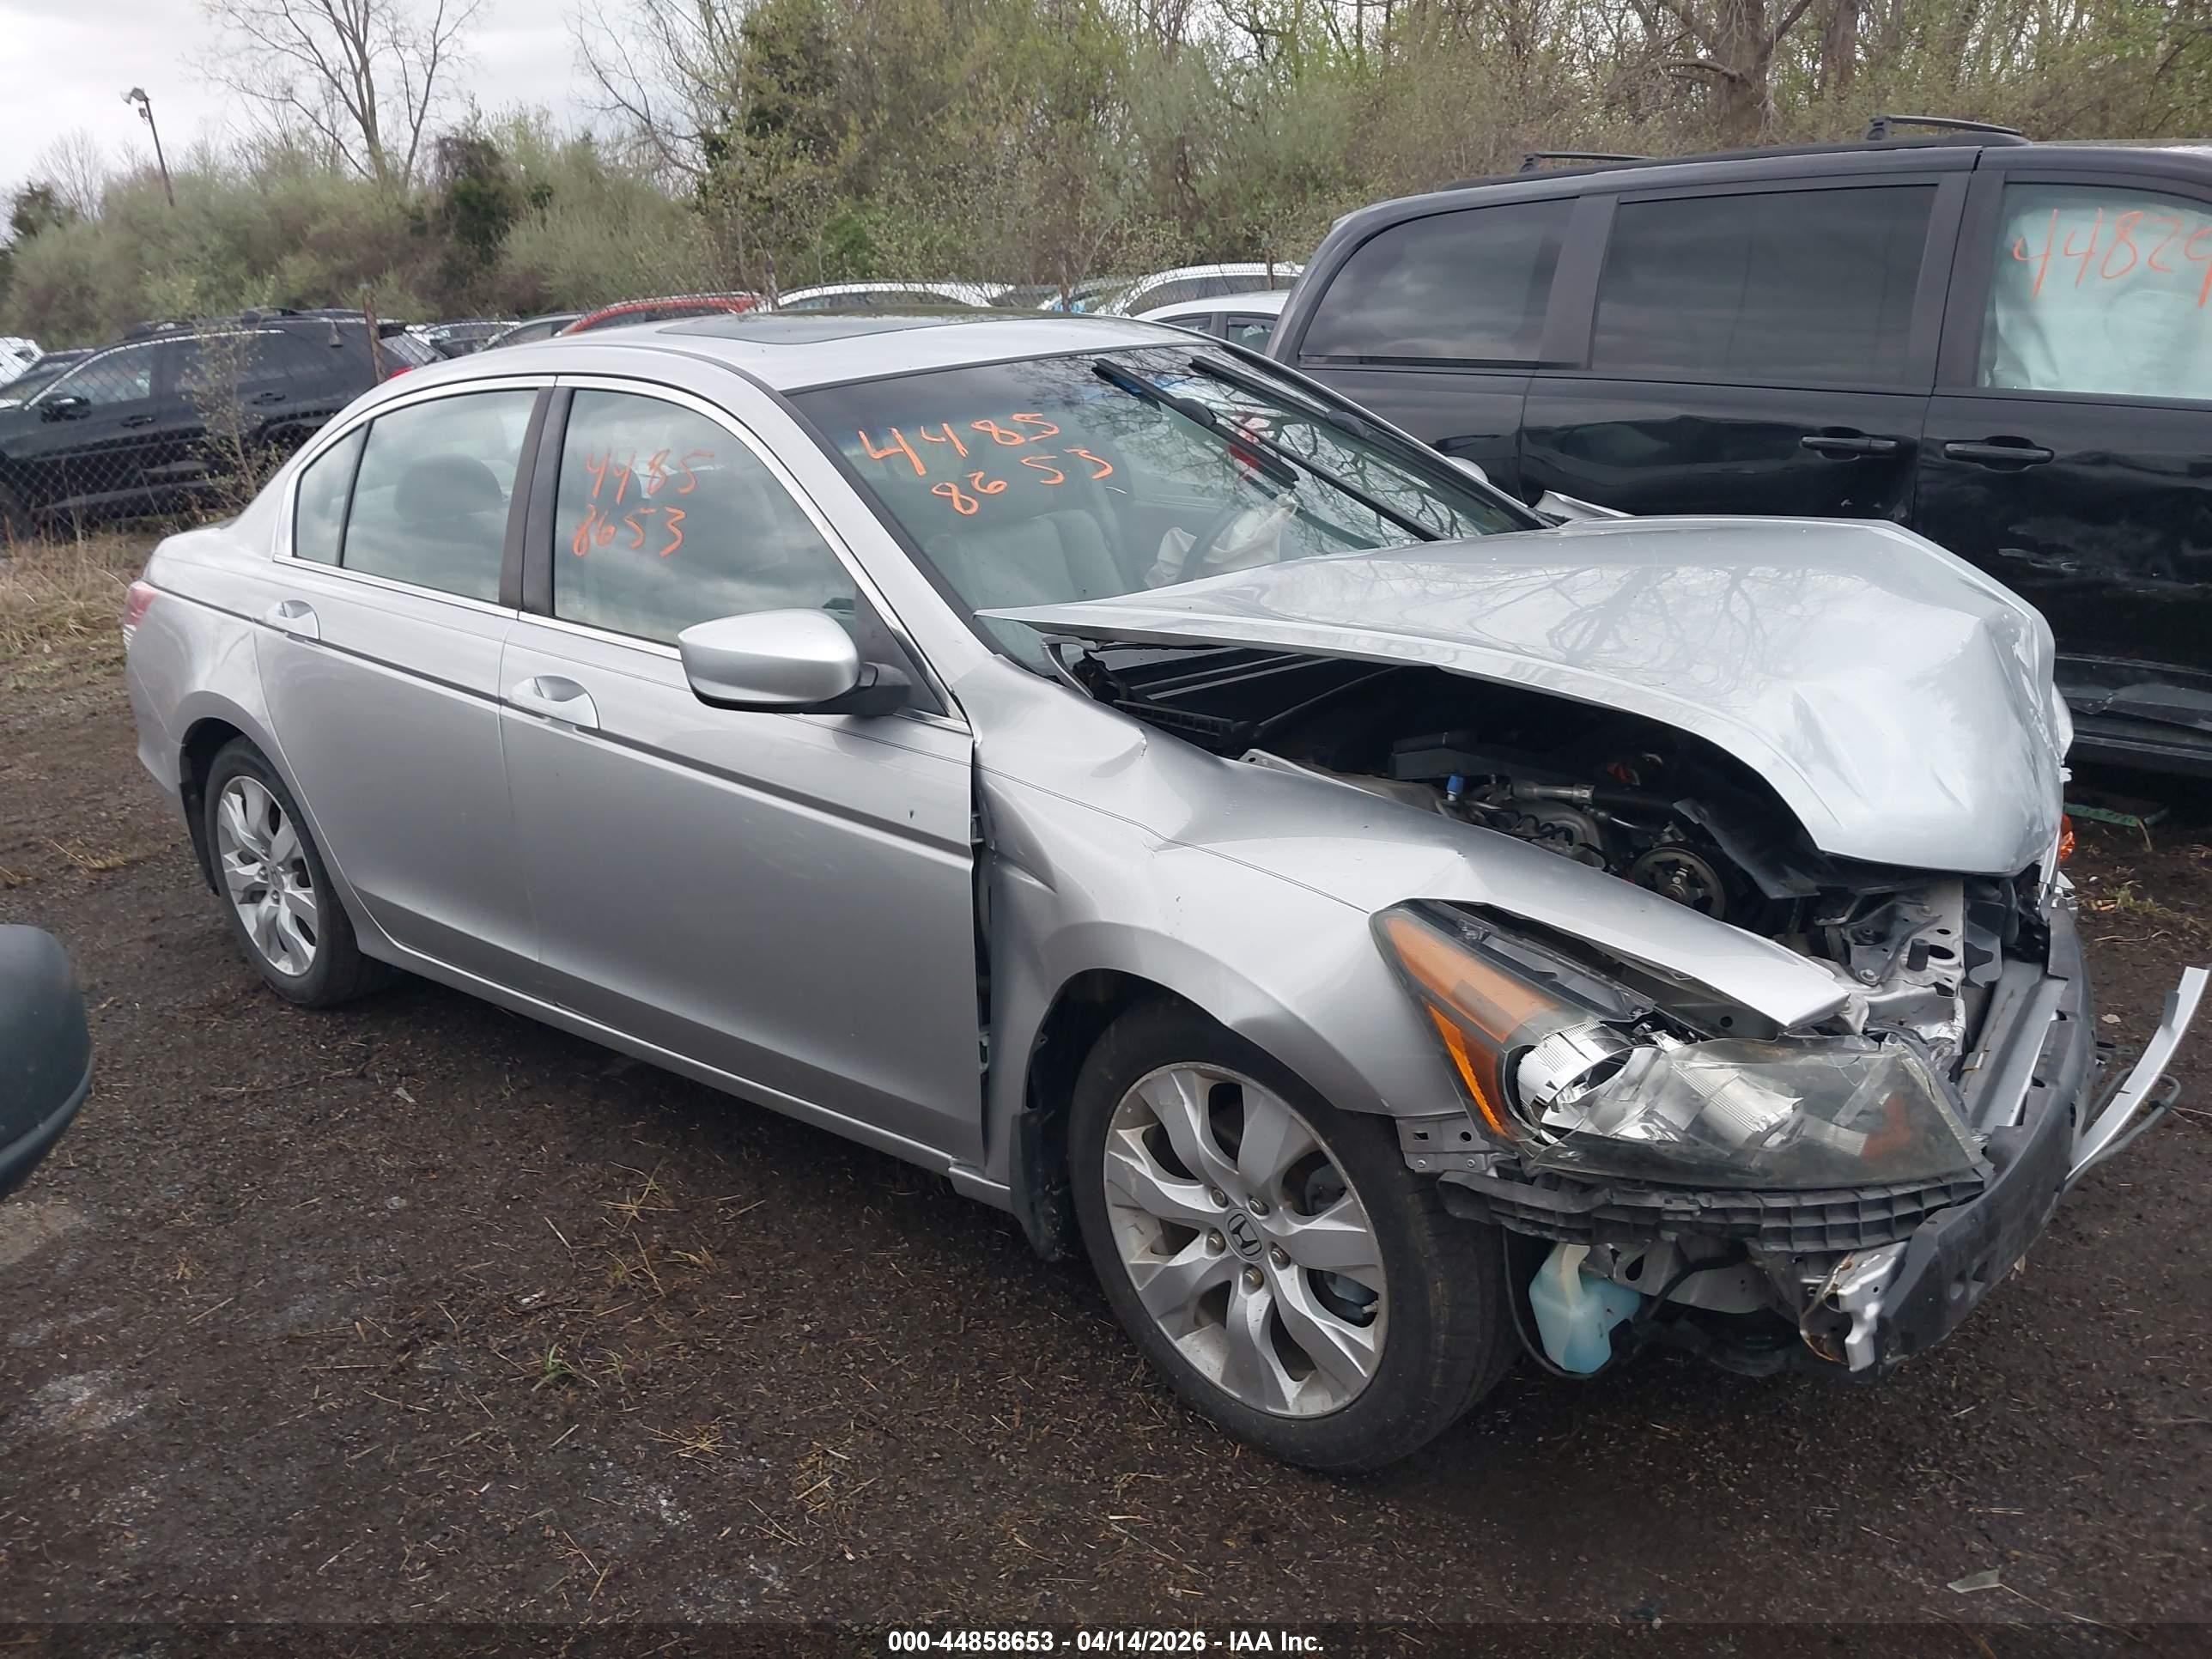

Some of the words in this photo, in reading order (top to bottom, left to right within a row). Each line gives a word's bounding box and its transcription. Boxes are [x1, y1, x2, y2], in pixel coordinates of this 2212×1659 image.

[859, 413, 1060, 477] 4485
[586, 448, 715, 505] 4485
[572, 503, 686, 556] 8653
